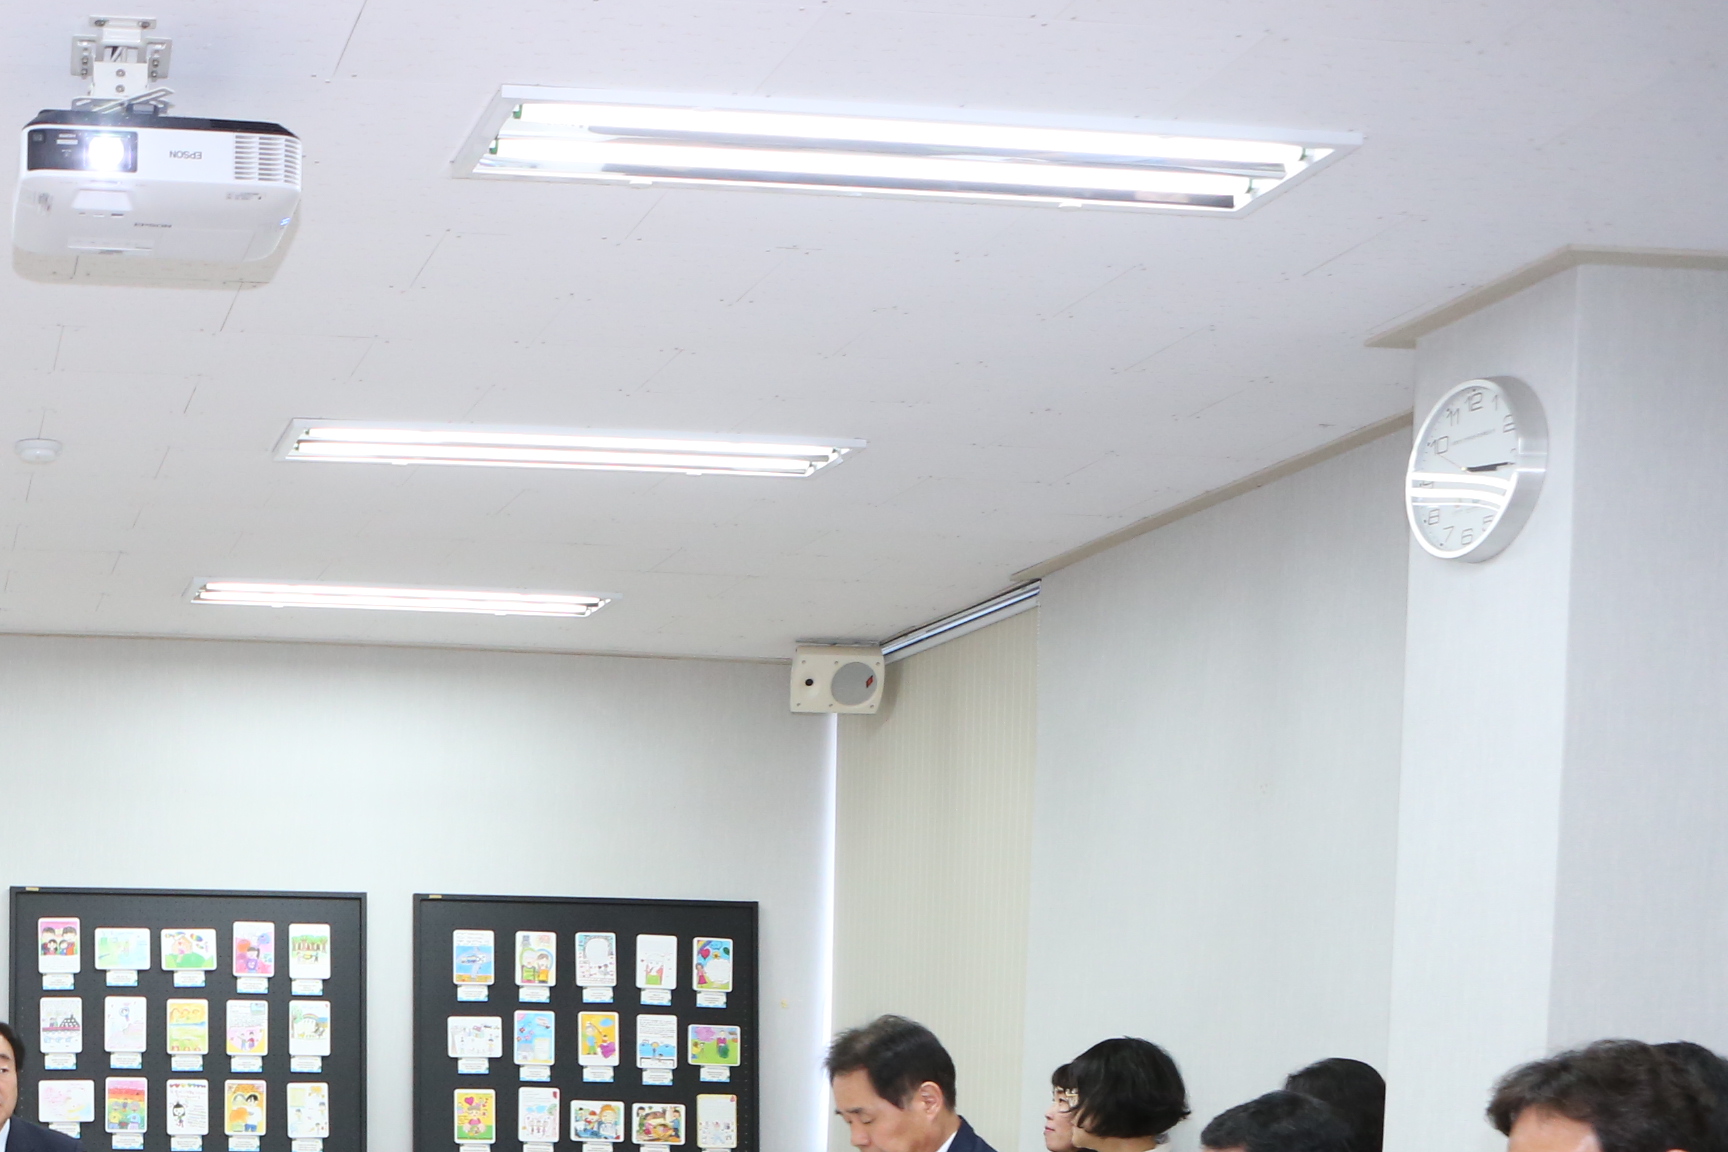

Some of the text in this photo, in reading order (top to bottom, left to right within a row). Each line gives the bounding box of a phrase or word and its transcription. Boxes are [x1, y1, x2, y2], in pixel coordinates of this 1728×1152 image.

[168, 150, 203, 160] EPSON
[1464, 391, 1484, 412] 12
[1445, 407, 1460, 426] 11
[1428, 435, 1449, 455] 10
[1442, 525, 1454, 543] 7
